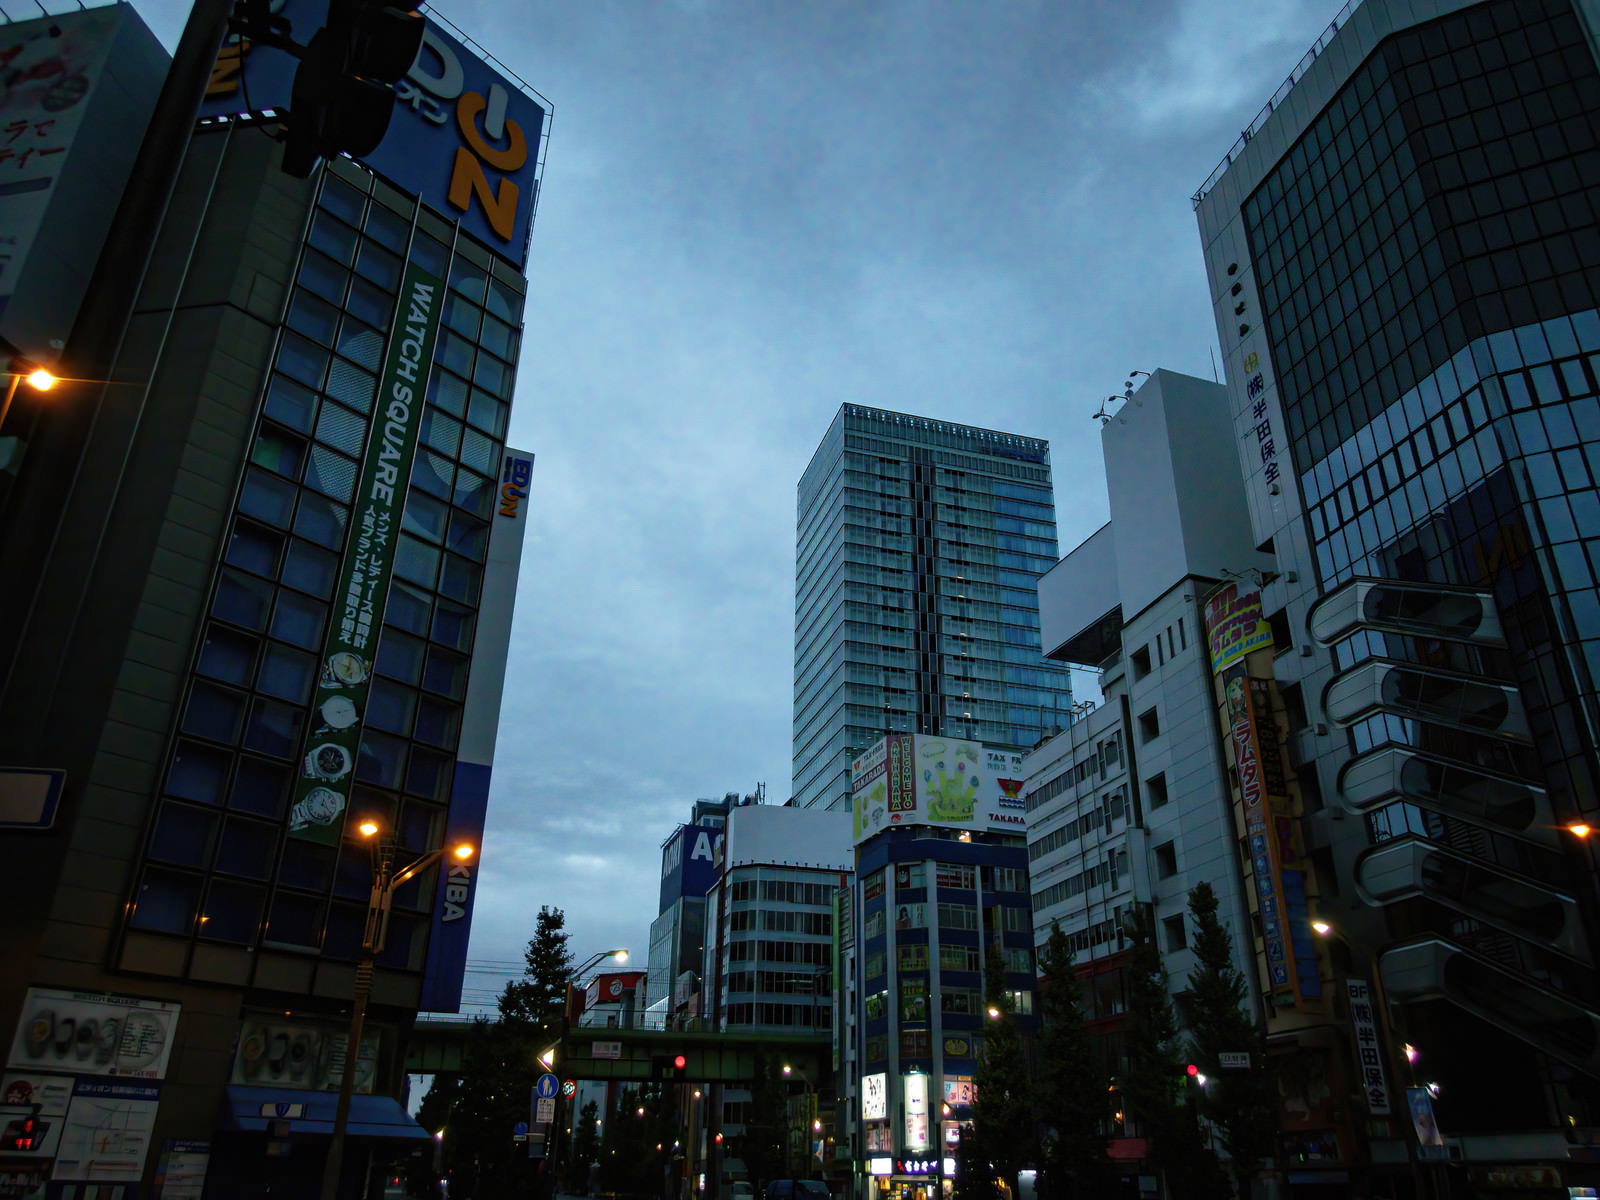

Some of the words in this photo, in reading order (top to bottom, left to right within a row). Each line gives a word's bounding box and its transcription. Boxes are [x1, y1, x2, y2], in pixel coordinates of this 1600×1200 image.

[396, 281, 434, 383] WATCH
[369, 381, 413, 507] SQUARE
[499, 459, 531, 518] EDION
[891, 743, 901, 810] AKIHABARA
[902, 737, 912, 789] WELCOME
[1232, 720, 1261, 807] ラムタラ
[904, 793, 913, 808] TO
[988, 813, 1026, 825] TAKARA
[441, 864, 472, 922] KIBA
